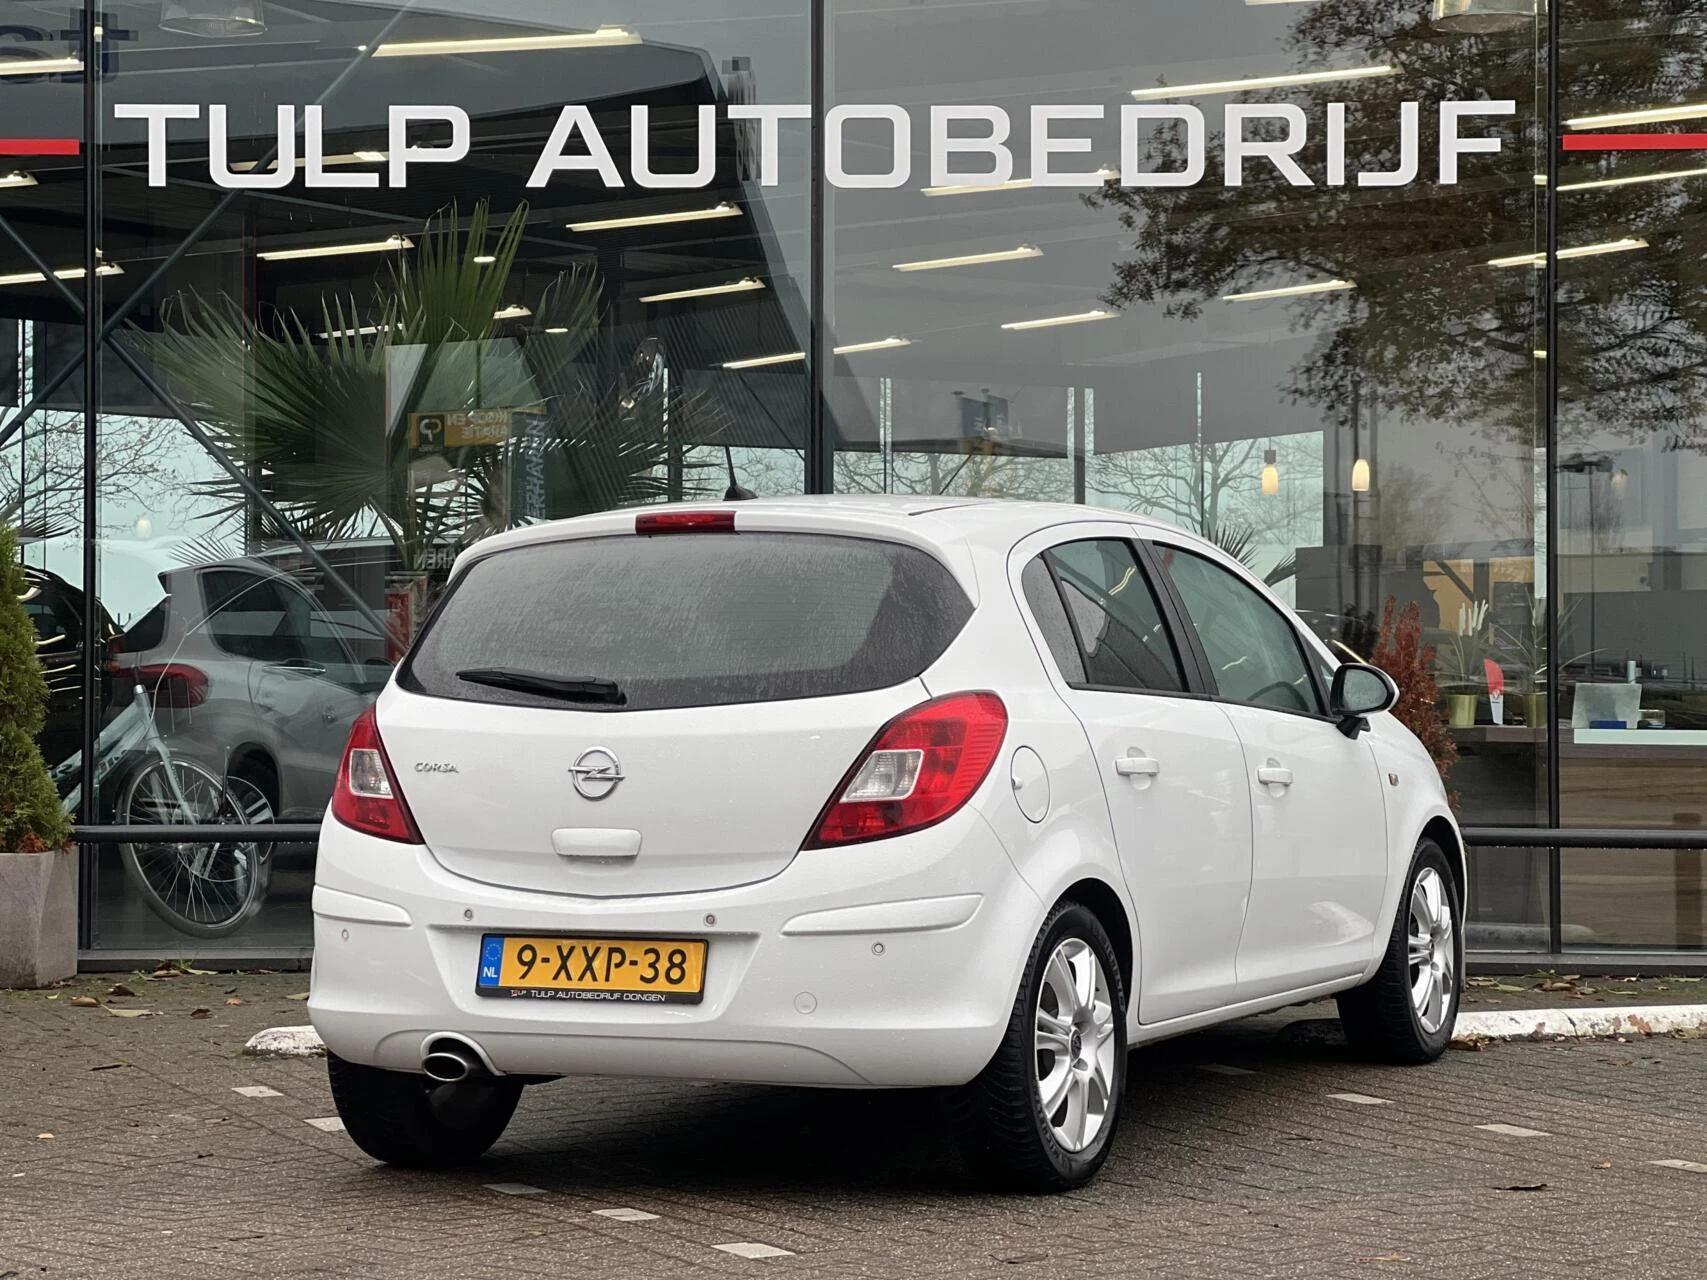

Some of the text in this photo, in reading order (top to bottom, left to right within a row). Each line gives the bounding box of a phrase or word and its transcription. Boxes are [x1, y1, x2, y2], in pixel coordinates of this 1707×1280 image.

[114, 100, 1516, 189] TULP AUTOBEDRIJF
[414, 762, 459, 774] CORSA
[516, 943, 688, 986] 9-XXP-38
[483, 966, 498, 978] NL
[530, 990, 666, 1002] TULP AUTOBEDRIJF DONGEN
